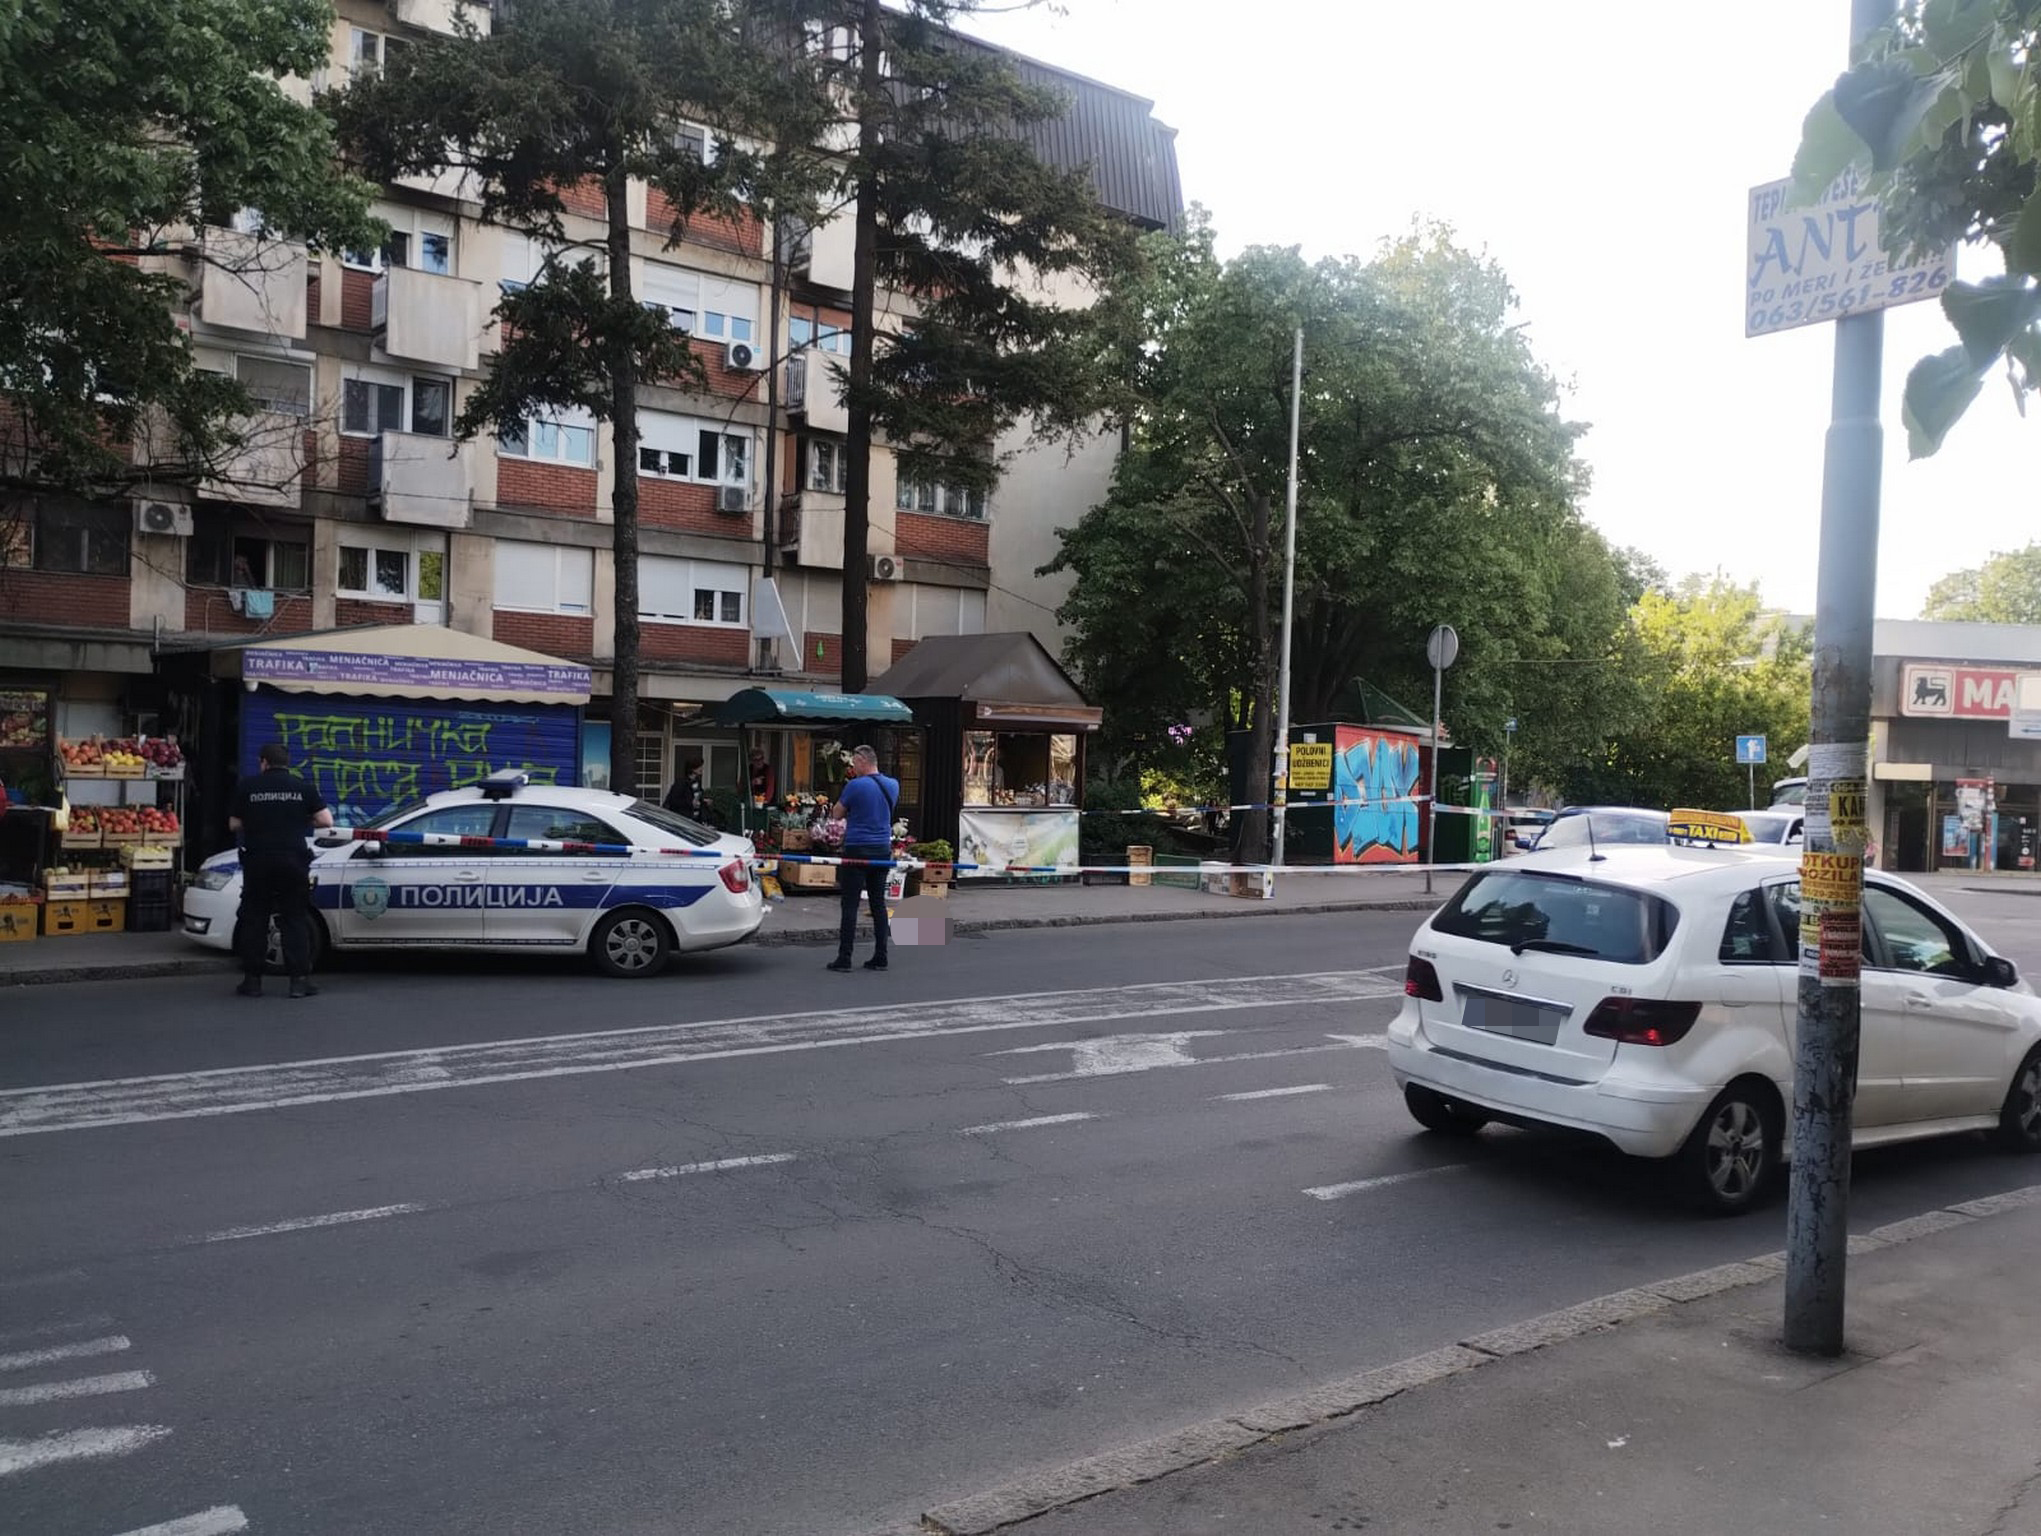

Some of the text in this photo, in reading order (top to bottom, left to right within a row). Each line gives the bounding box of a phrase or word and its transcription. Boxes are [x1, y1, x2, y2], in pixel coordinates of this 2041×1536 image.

[1750, 289, 1775, 307] PO
[1782, 273, 1836, 300] MERI
[1750, 265, 1948, 331] 063/561-826
[248, 658, 305, 672] TRAFIKA
[329, 655, 390, 667] MENJAČNICA
[340, 672, 379, 683] TRAFIKA
[429, 668, 505, 684] MENJAČNICA
[547, 669, 591, 682] TRAFIKA
[1962, 677, 2014, 710] MA
[250, 792, 303, 802] ПОЛИЦИЈА
[1688, 824, 1719, 839] TAXI
[400, 885, 564, 908] ПОЛИЦИЈА
